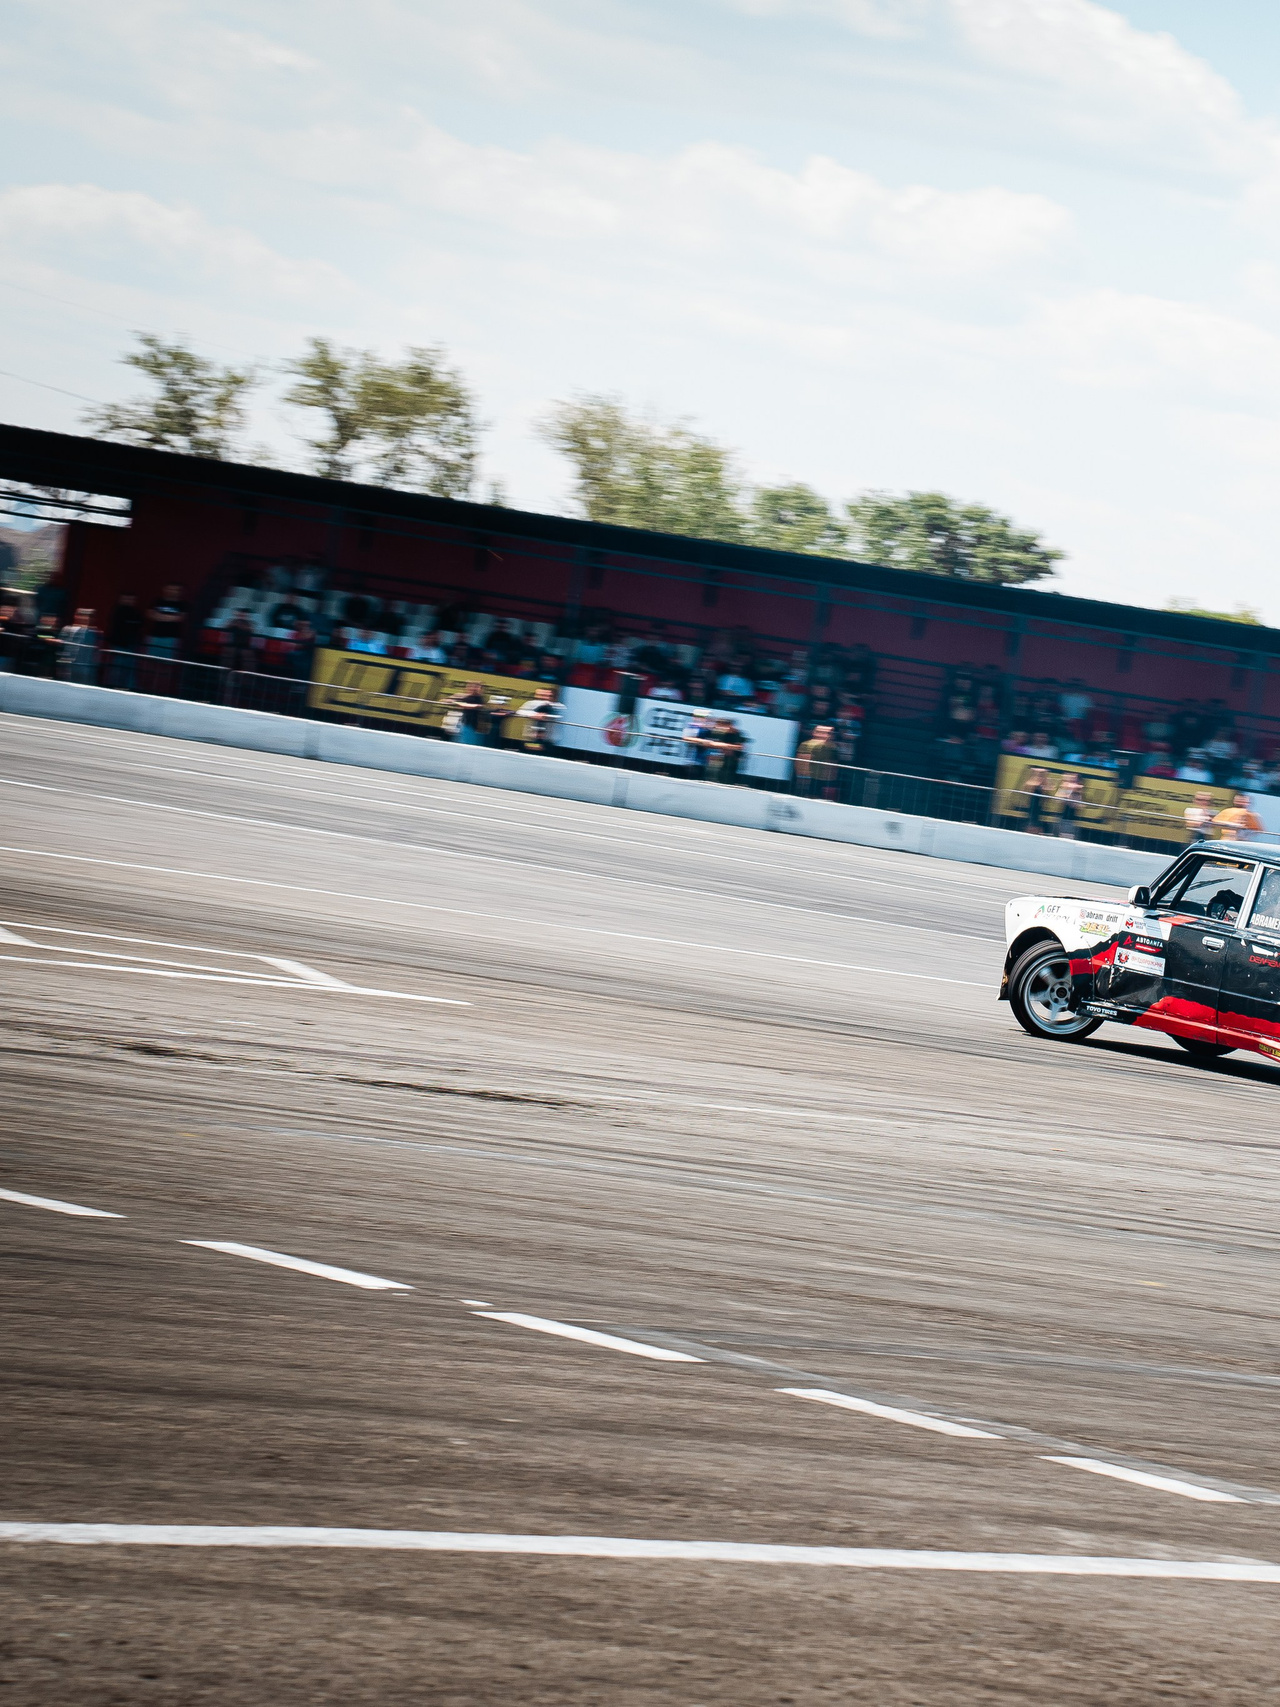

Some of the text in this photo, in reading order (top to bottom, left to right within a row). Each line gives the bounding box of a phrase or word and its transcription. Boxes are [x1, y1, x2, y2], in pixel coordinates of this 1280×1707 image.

[1046, 904, 1061, 914] GET
[1086, 1005, 1118, 1016] TOYO TIRES
